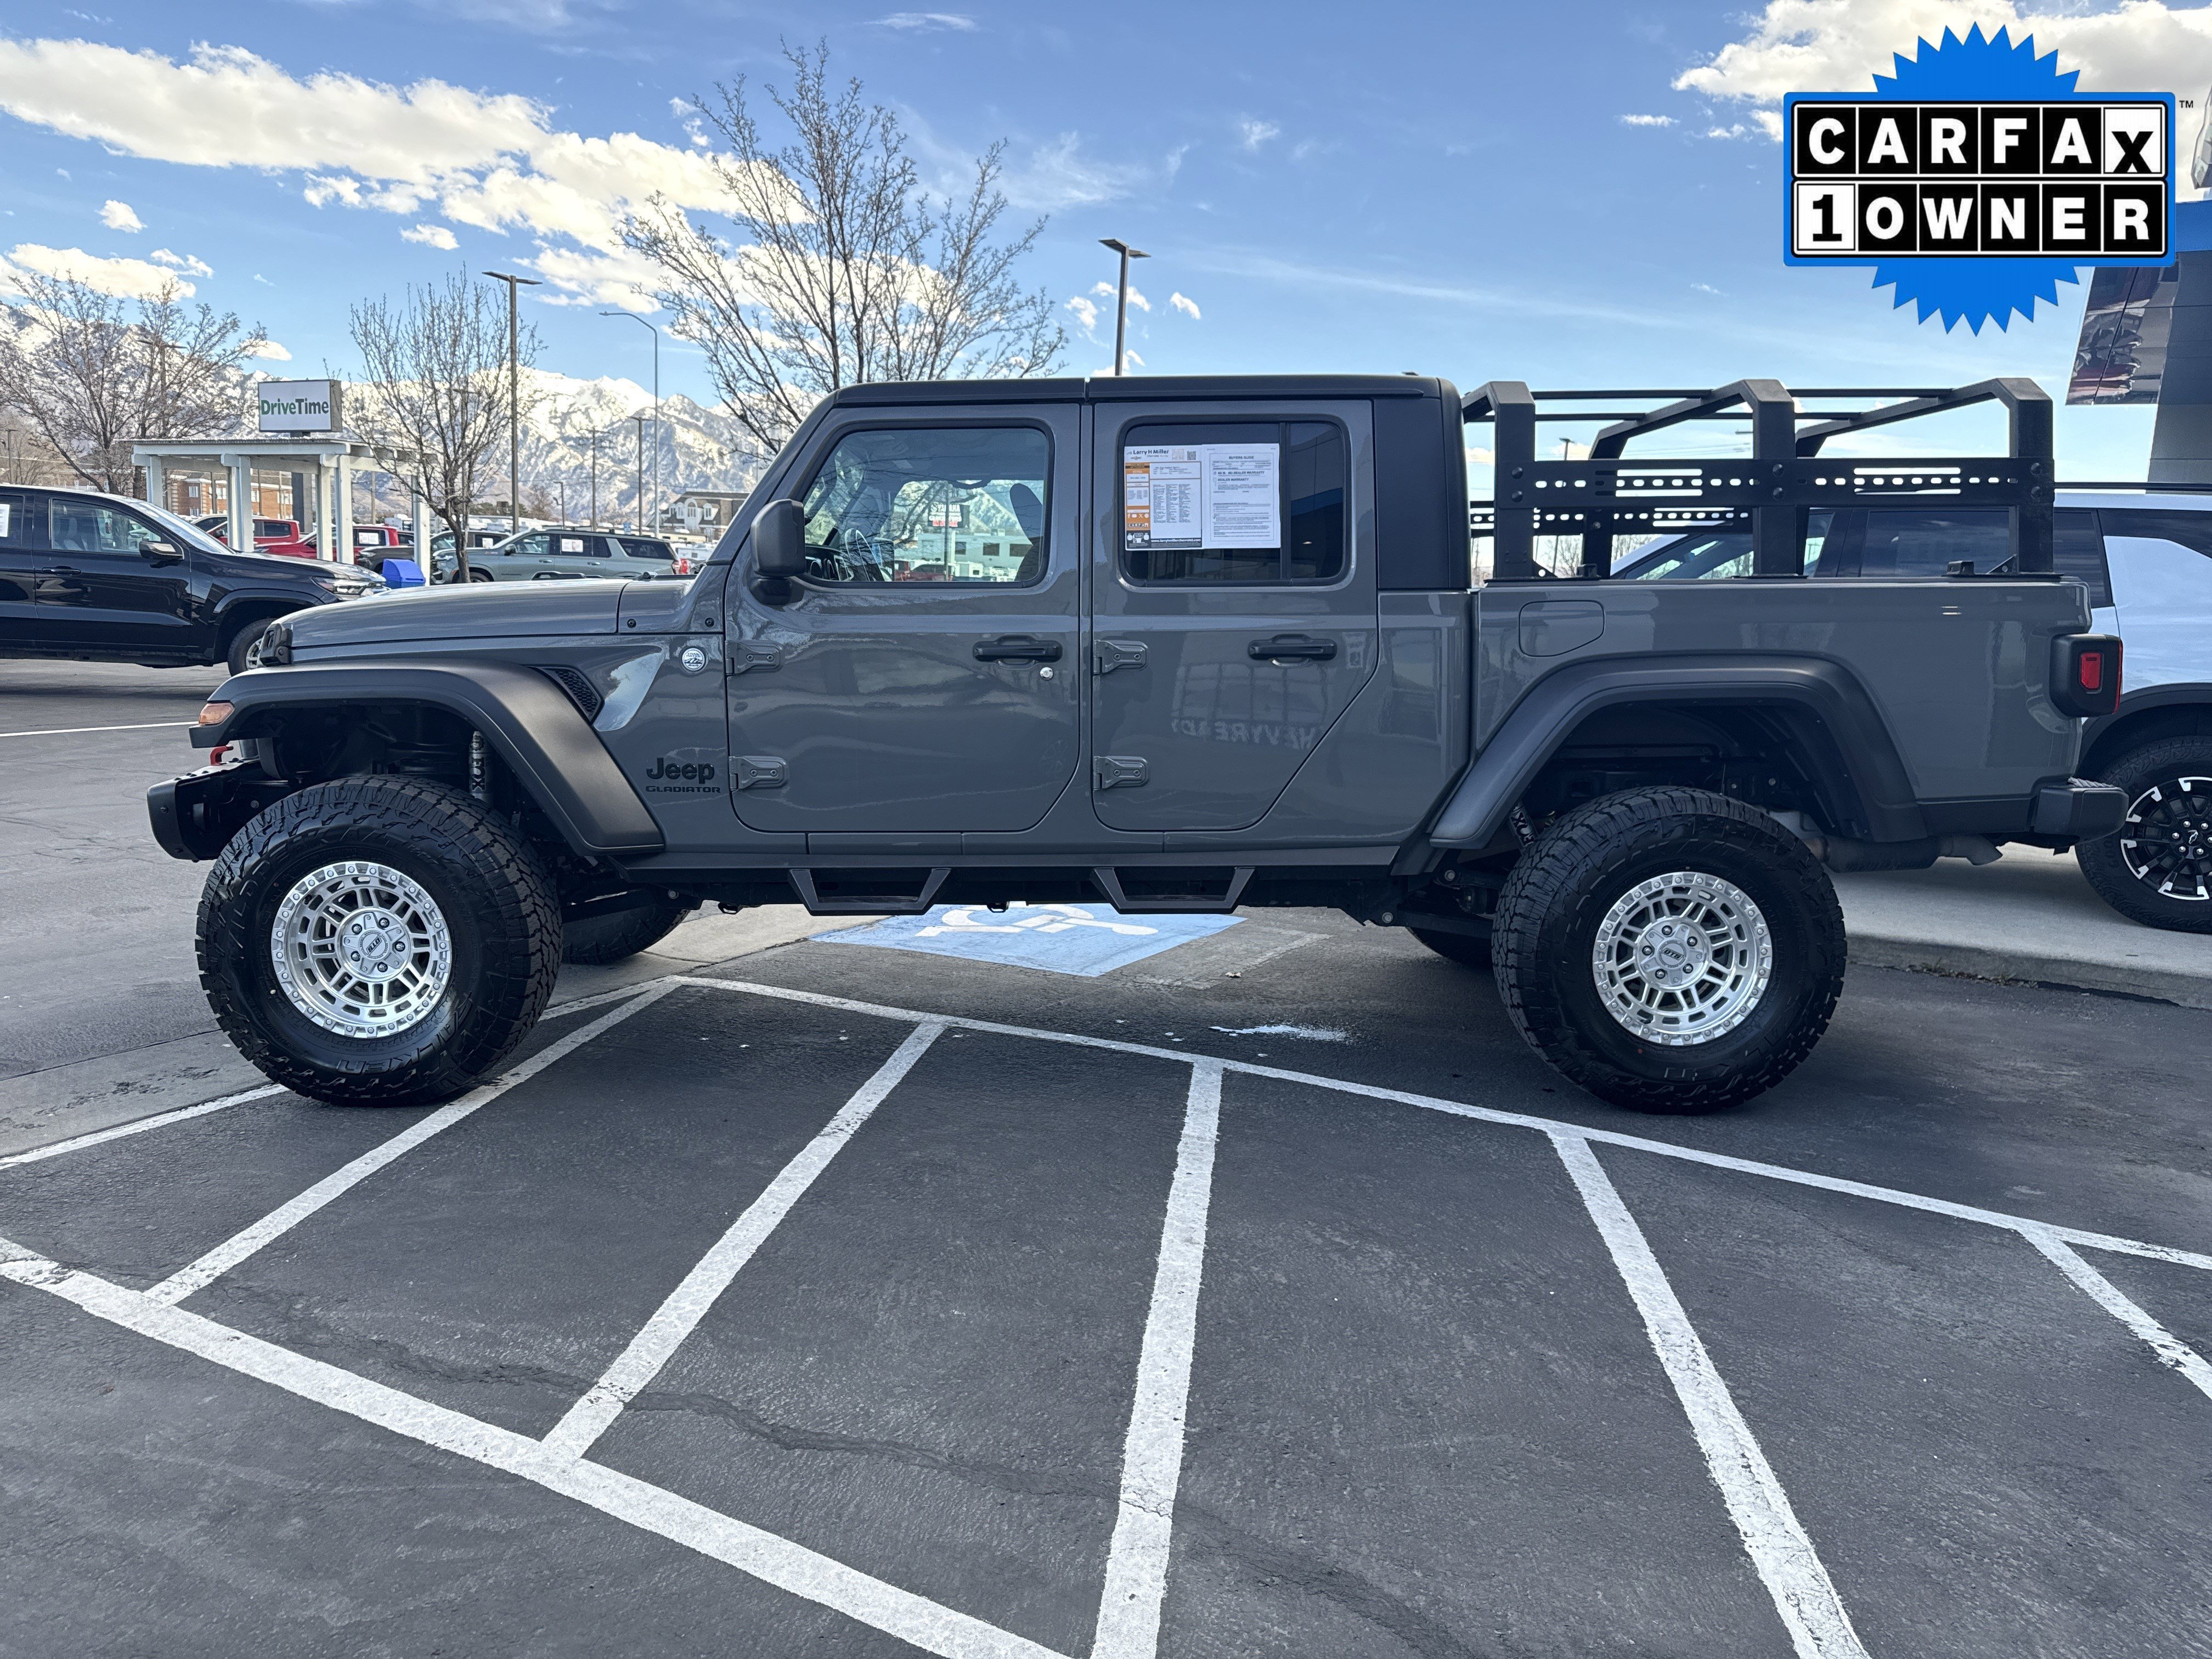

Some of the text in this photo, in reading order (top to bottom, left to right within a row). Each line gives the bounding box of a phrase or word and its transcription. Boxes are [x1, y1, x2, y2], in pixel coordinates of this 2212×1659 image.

[261, 397, 329, 415] DriveTime
[471, 758, 486, 791] FOX
[646, 757, 715, 784] Jeep
[645, 785, 721, 793] GLADIATOR
[1510, 812, 1535, 846] FOX
